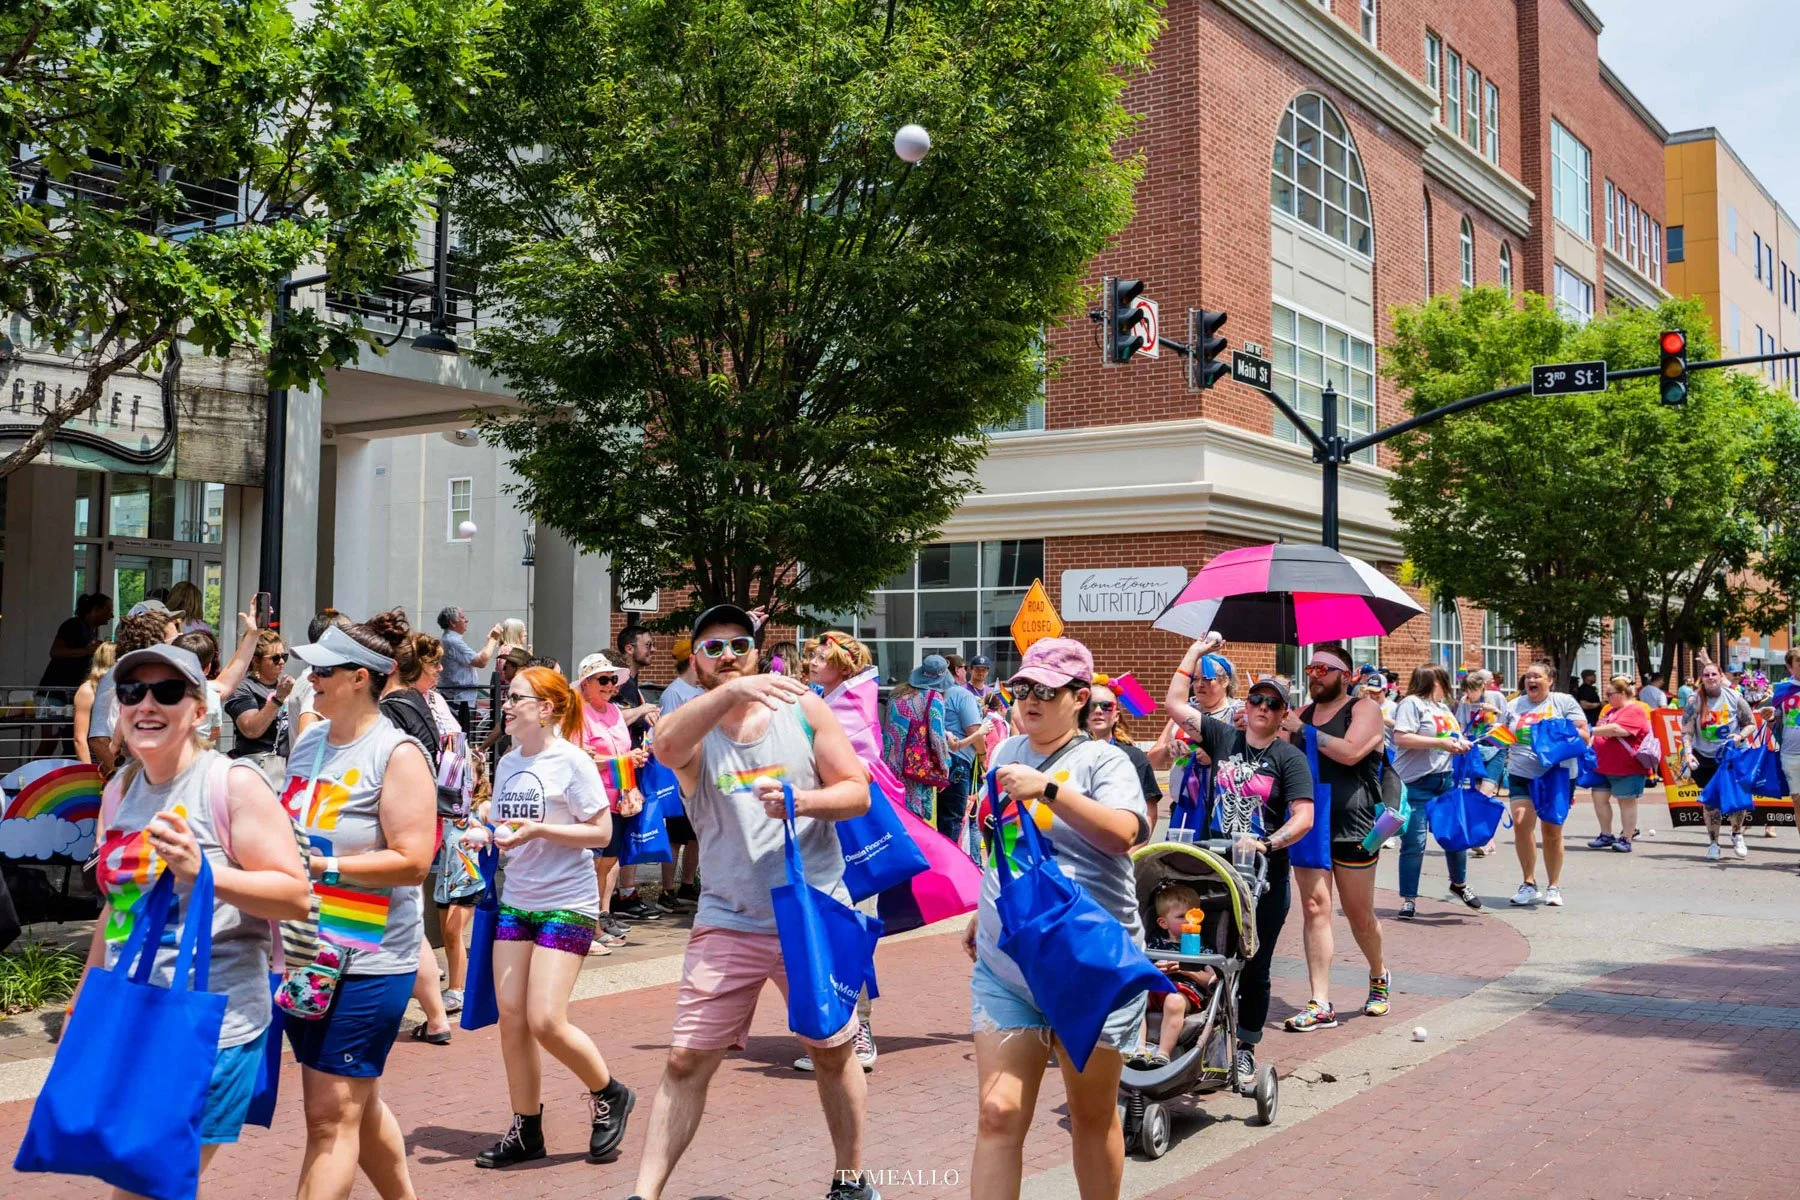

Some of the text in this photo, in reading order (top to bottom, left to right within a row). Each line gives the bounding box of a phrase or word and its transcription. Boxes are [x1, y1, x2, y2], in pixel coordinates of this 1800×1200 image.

[1237, 359, 1268, 384] Main St
[1543, 369, 1594, 388] 3RD St
[12, 377, 142, 432] CRICET
[1080, 574, 1169, 591] hometown
[1027, 600, 1045, 613] ROAD
[1021, 620, 1052, 633] CLOSED
